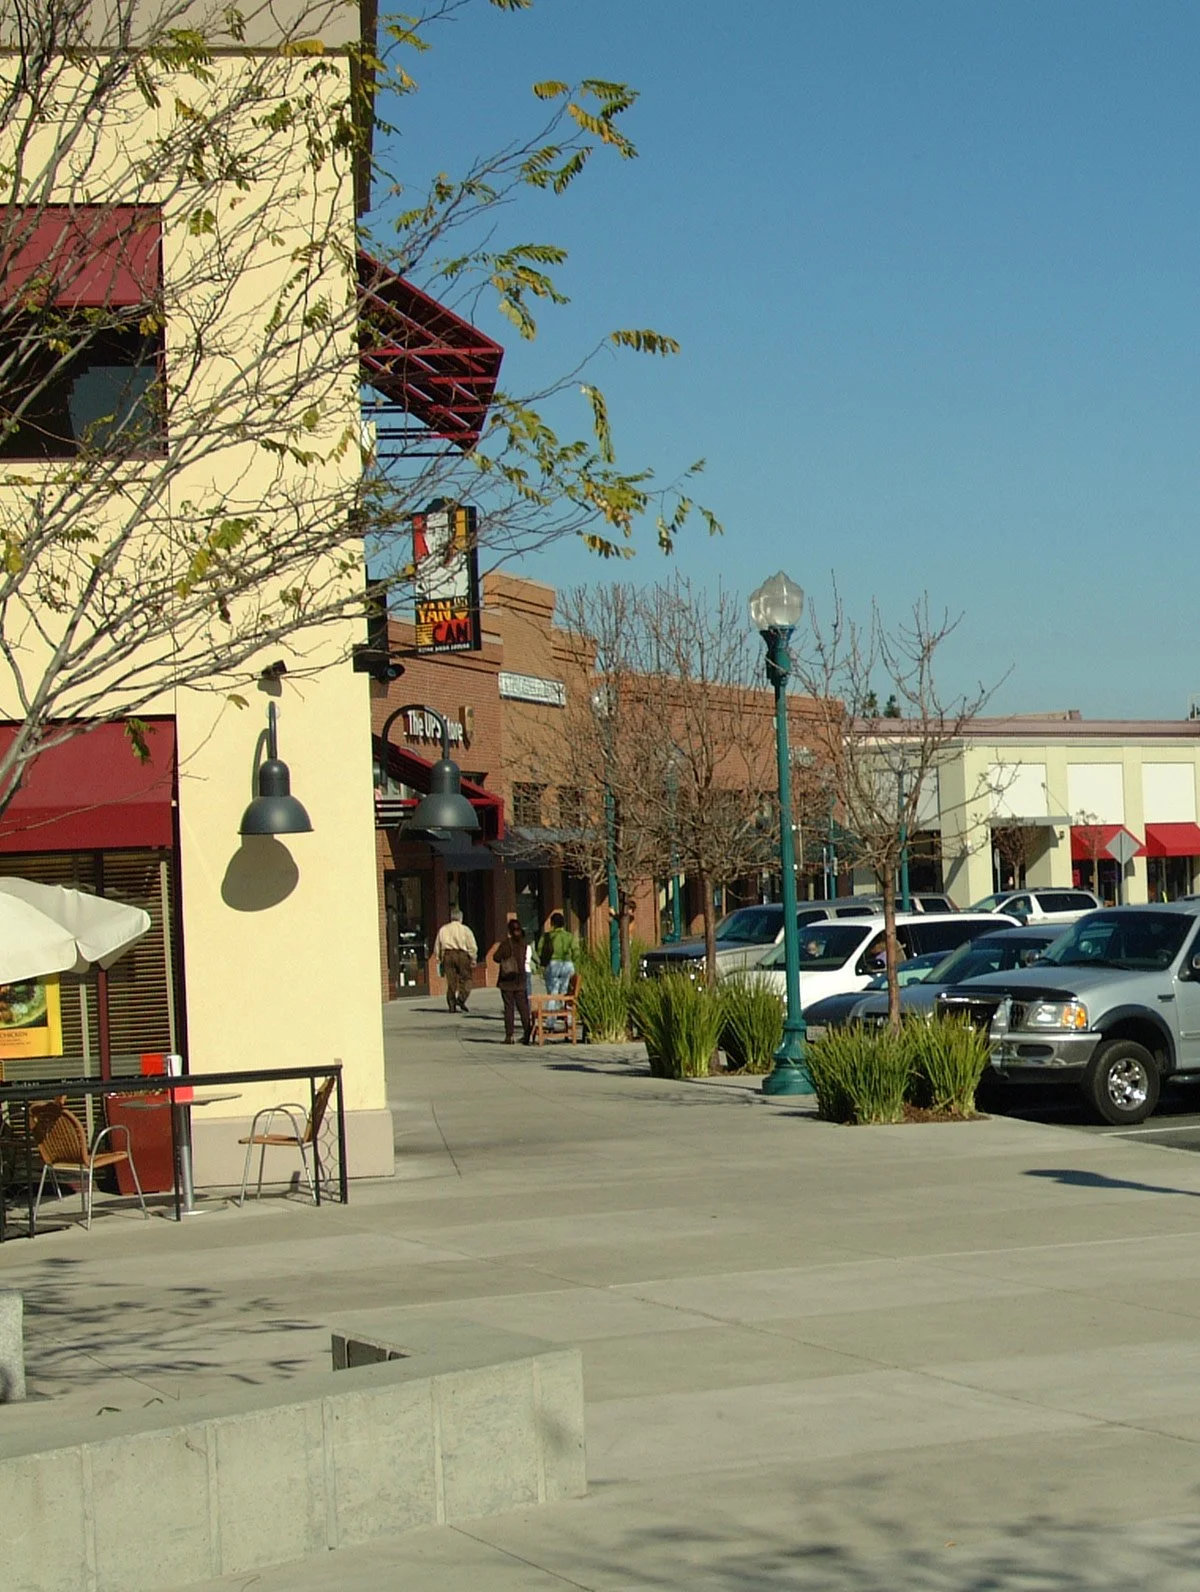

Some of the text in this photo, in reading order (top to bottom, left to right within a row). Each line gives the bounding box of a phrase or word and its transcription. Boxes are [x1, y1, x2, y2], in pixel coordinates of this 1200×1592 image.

[416, 600, 451, 624] YAN
[433, 621, 469, 644] CAN
[407, 709, 425, 737] The
[424, 711, 442, 739] UPS
